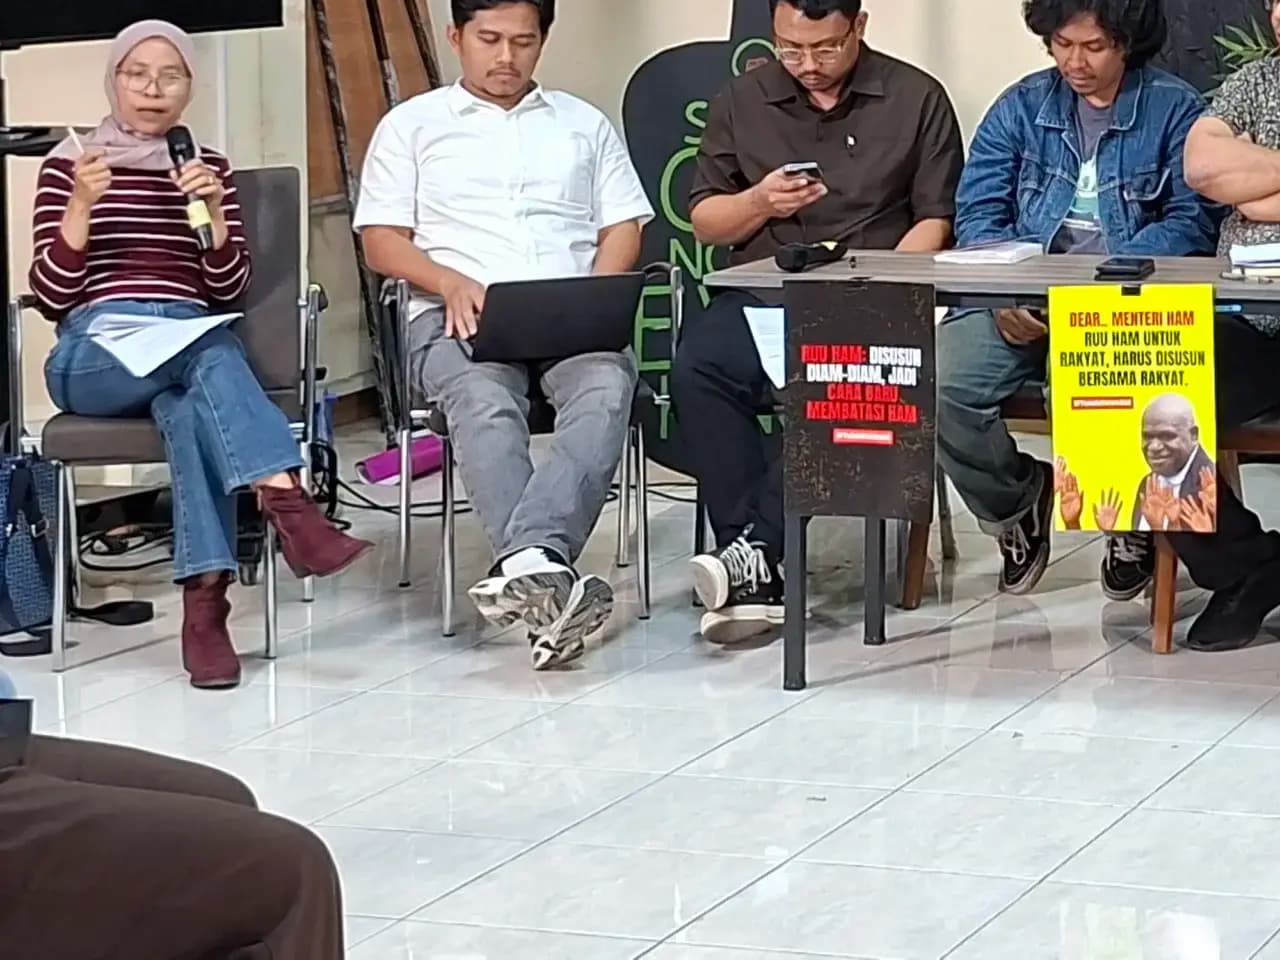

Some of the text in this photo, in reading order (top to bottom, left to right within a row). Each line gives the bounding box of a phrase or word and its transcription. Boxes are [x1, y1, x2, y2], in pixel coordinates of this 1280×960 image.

[1111, 311, 1163, 327] MENTERI
[1166, 310, 1195, 326] HAM
[1084, 331, 1181, 347] RUU HAM UNTUK
[801, 344, 828, 362] RUU
[869, 345, 923, 367] DISUSUN
[1113, 351, 1152, 367] HARUS
[1155, 350, 1206, 367] DISUSUN
[887, 366, 918, 386] JADI
[1078, 370, 1138, 387] BERSAMA
[827, 383, 900, 402] CARA BARU
[806, 400, 918, 423] MEMBATASI HAM
